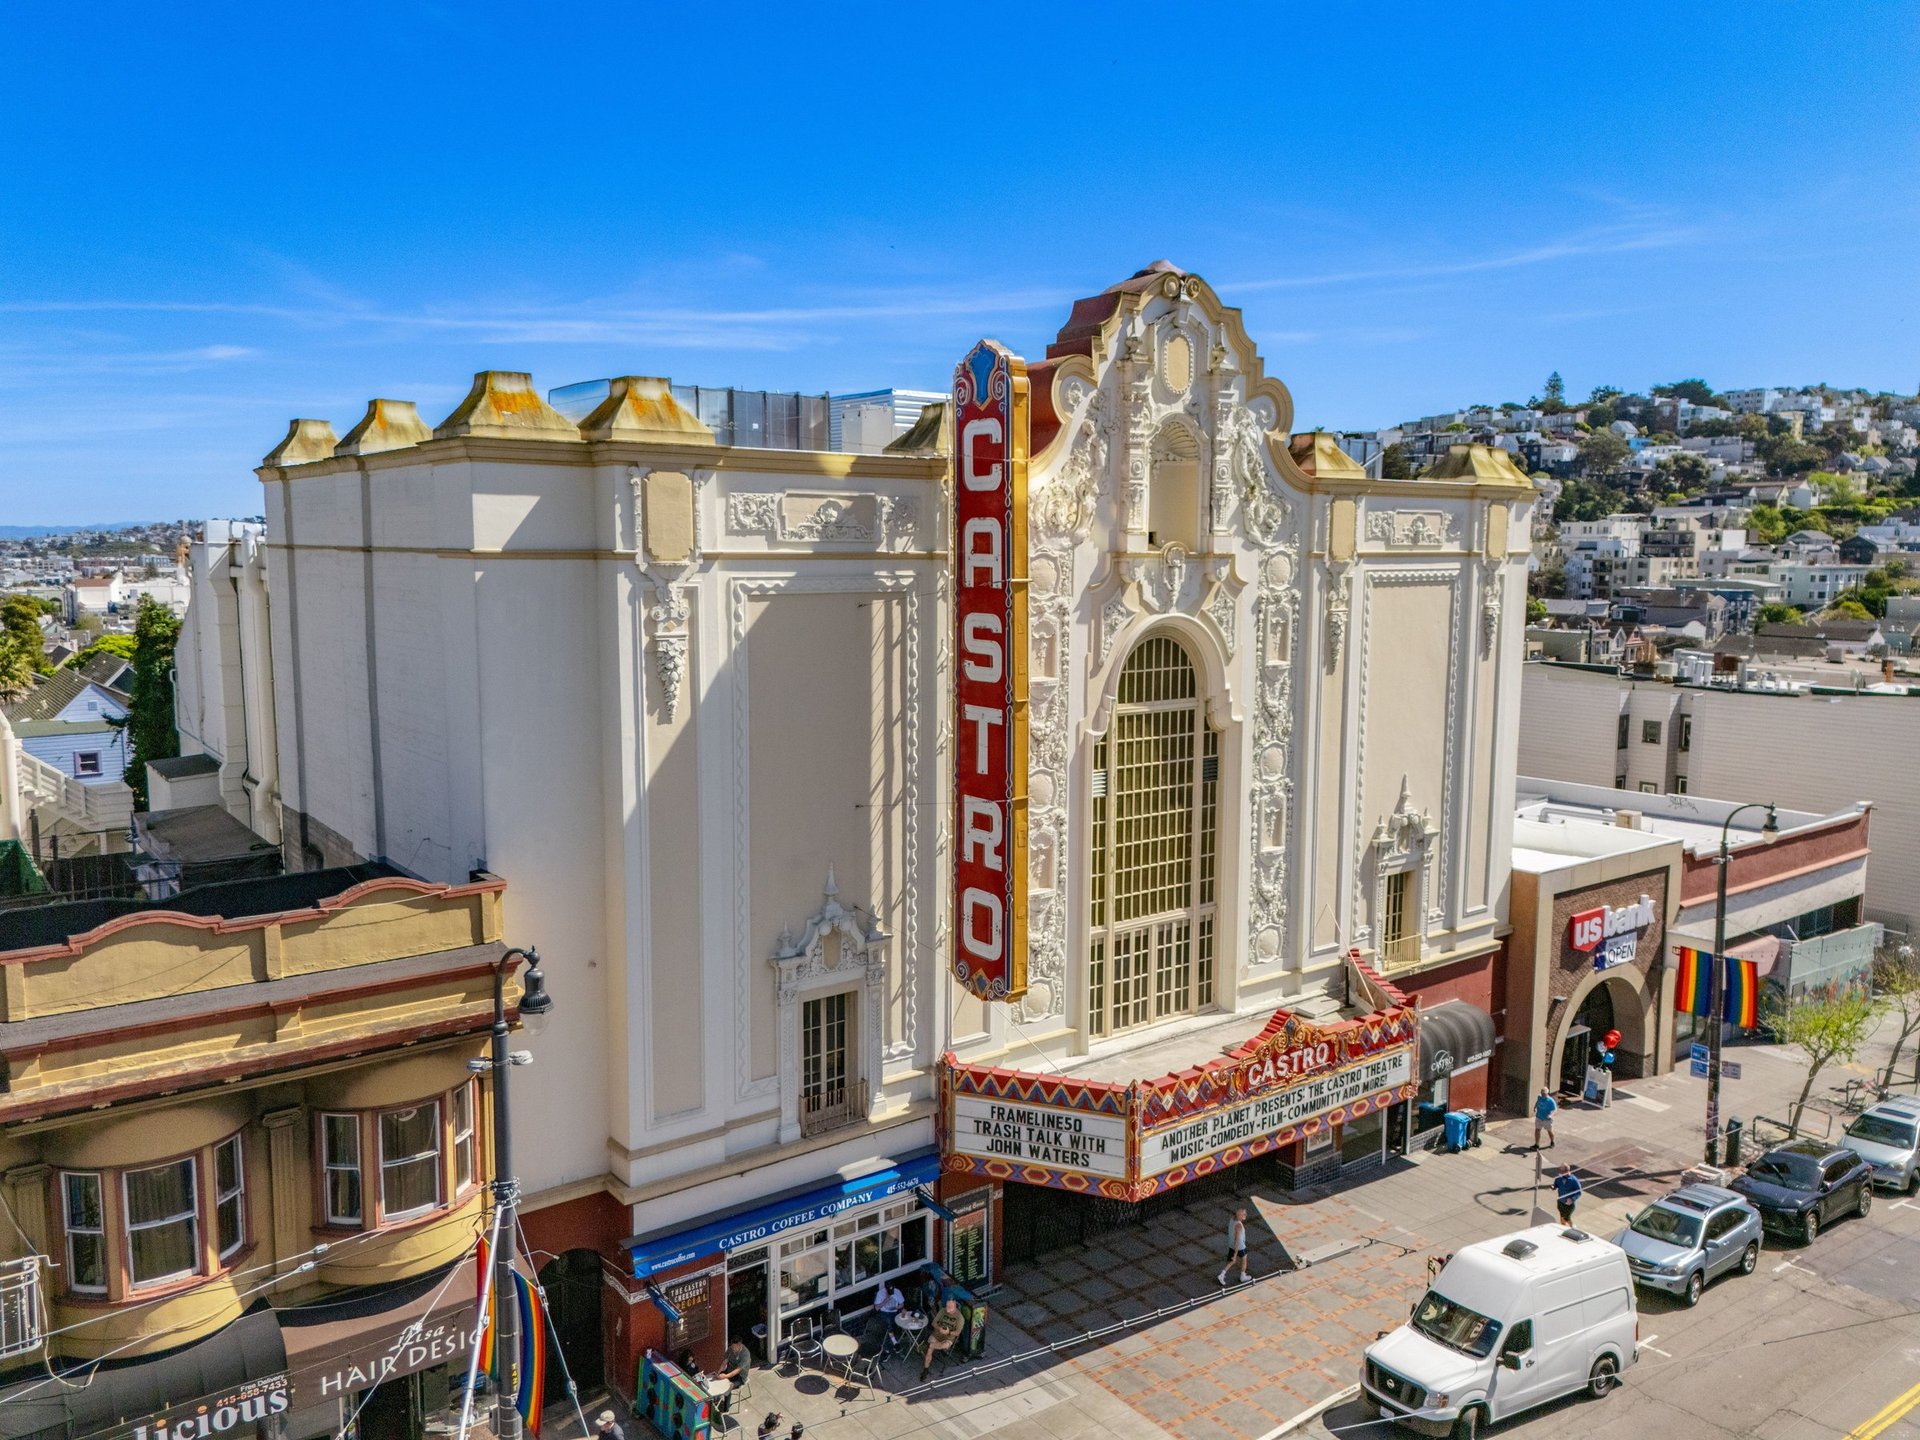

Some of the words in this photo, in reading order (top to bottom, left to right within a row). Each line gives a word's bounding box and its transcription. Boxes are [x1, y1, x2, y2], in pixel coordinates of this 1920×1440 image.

[962, 417, 1003, 962] CASTRO
[1608, 943, 1634, 963] OPEN
[1248, 1042, 1331, 1086] CASTRO
[1161, 1121, 1208, 1150] ANOTHER
[1213, 1106, 1251, 1132] PLANET
[1308, 1082, 1325, 1098] THE
[1327, 1069, 1361, 1094] CASTRO
[1365, 1055, 1403, 1078] THEATRE
[1343, 1085, 1360, 1100] AND
[1362, 1074, 1388, 1094] MORE!
[974, 1119, 1022, 1140] TRASH
[1026, 1128, 1063, 1147] TALK
[1069, 1134, 1106, 1153] WITH
[986, 1139, 1022, 1156] JOHN
[1028, 1144, 1090, 1168] WATERS
[718, 1226, 767, 1249] CASTRO
[771, 1210, 815, 1232] COFFEE
[820, 1191, 873, 1215] COMPANY
[671, 1287, 683, 1297] THE
[322, 1356, 397, 1395] HAIR
[409, 1329, 478, 1367] DESI
[240, 1382, 256, 1392] Free
[257, 1373, 285, 1387] Delivery
